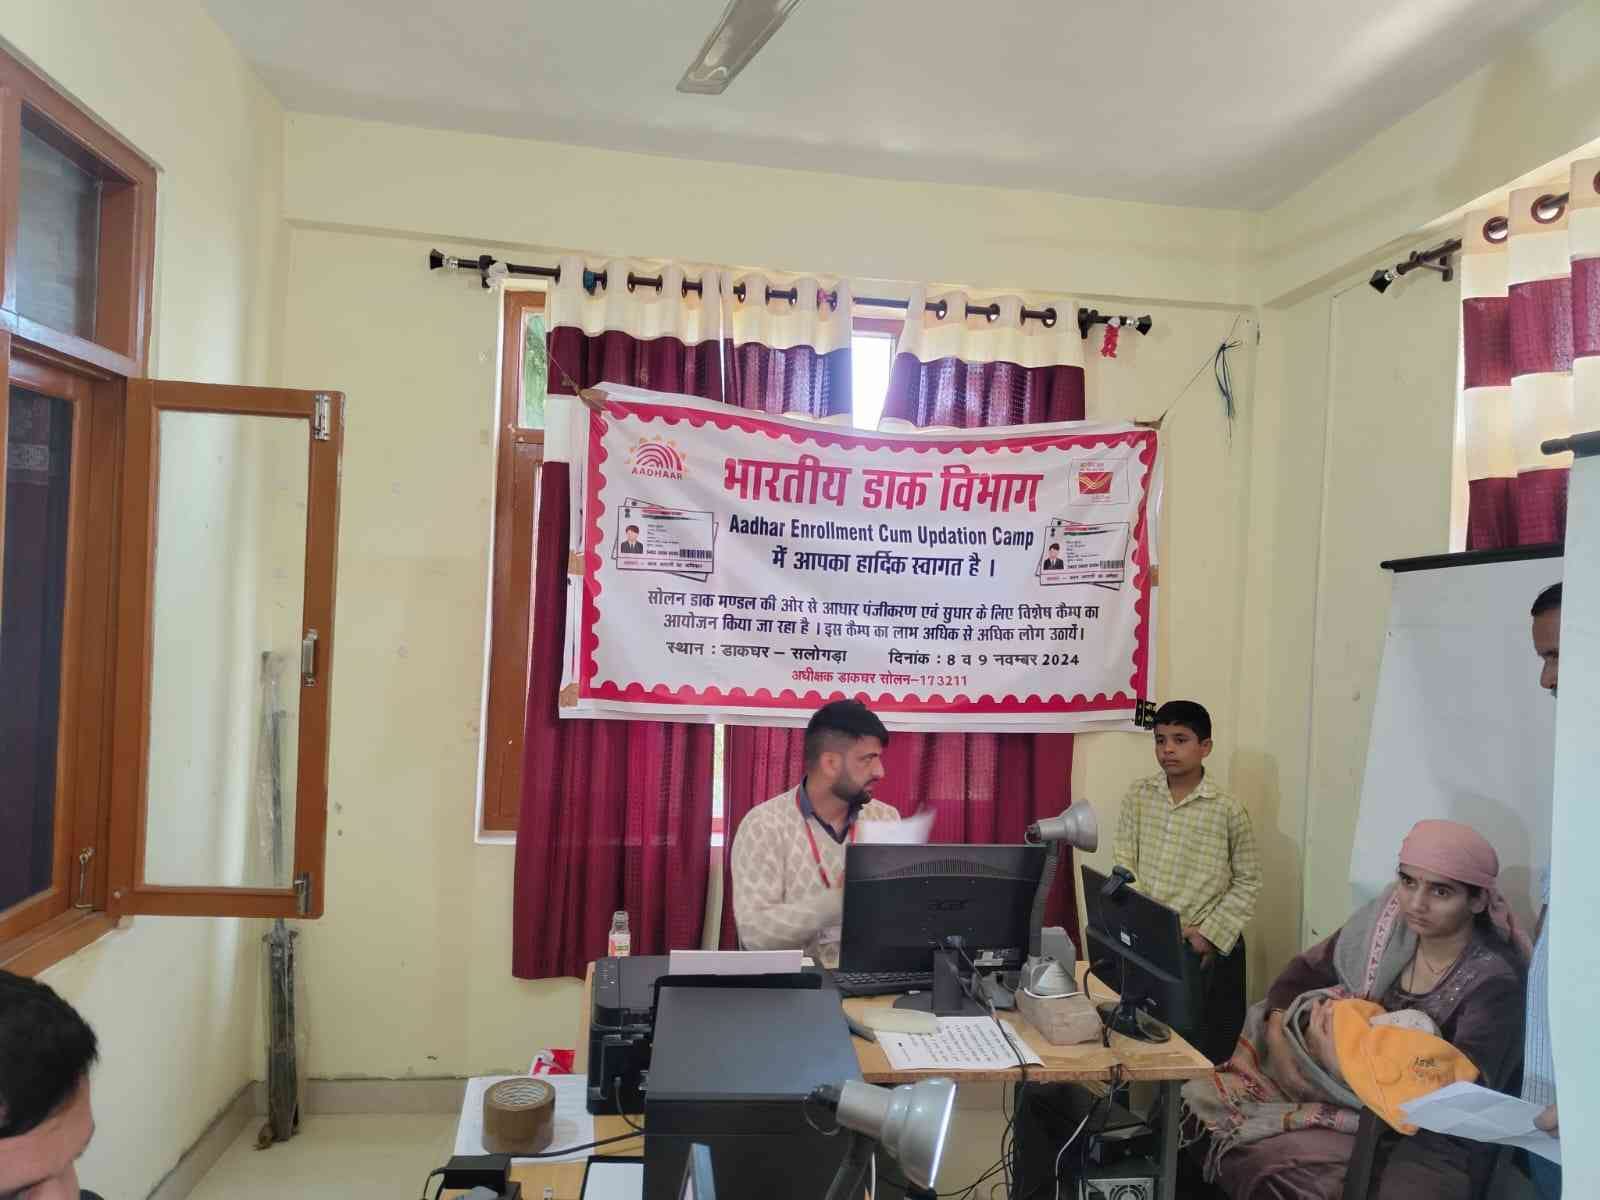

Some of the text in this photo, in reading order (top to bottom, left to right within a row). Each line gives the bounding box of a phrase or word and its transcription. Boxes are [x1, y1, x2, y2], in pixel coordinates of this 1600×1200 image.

[631, 467, 683, 481] AADHAAR
[724, 454, 1044, 512] भारतीय डाक विभाग
[729, 514, 1034, 550] Aadhar Enrollment Cum Updation Camp
[771, 545, 788, 568] में
[793, 551, 851, 573] आपका
[856, 550, 908, 574] हार्दिक
[912, 556, 965, 576] स्वागत
[970, 553, 982, 576] है
[648, 587, 1099, 623] सोलन डाक मण्डल की ओर से आधार पंजीकरण एवं सुधार के लिए विशेष कैम्प का
[663, 611, 717, 630] आयोजन
[722, 613, 751, 632] किया
[756, 618, 773, 633] जा
[777, 620, 796, 634] रहा
[800, 616, 810, 635] है
[825, 621, 842, 637] इस
[874, 625, 888, 639] का
[892, 624, 917, 640] लाभ
[923, 624, 959, 641] अधिक
[962, 624, 973, 641] से
[977, 625, 1014, 641] अधिक
[1018, 624, 1045, 641] लोग
[666, 641, 704, 656] स्थान
[720, 643, 770, 658] डाकघर
[888, 648, 930, 665] दिनांक
[947, 654, 956, 666] 8
[961, 654, 972, 666] व
[978, 654, 988, 666] 9
[993, 653, 1038, 666] नवम्बर
[1042, 653, 1080, 666] 2024
[791, 666, 833, 683] अधीक्षक
[838, 671, 875, 685] डाकघर
